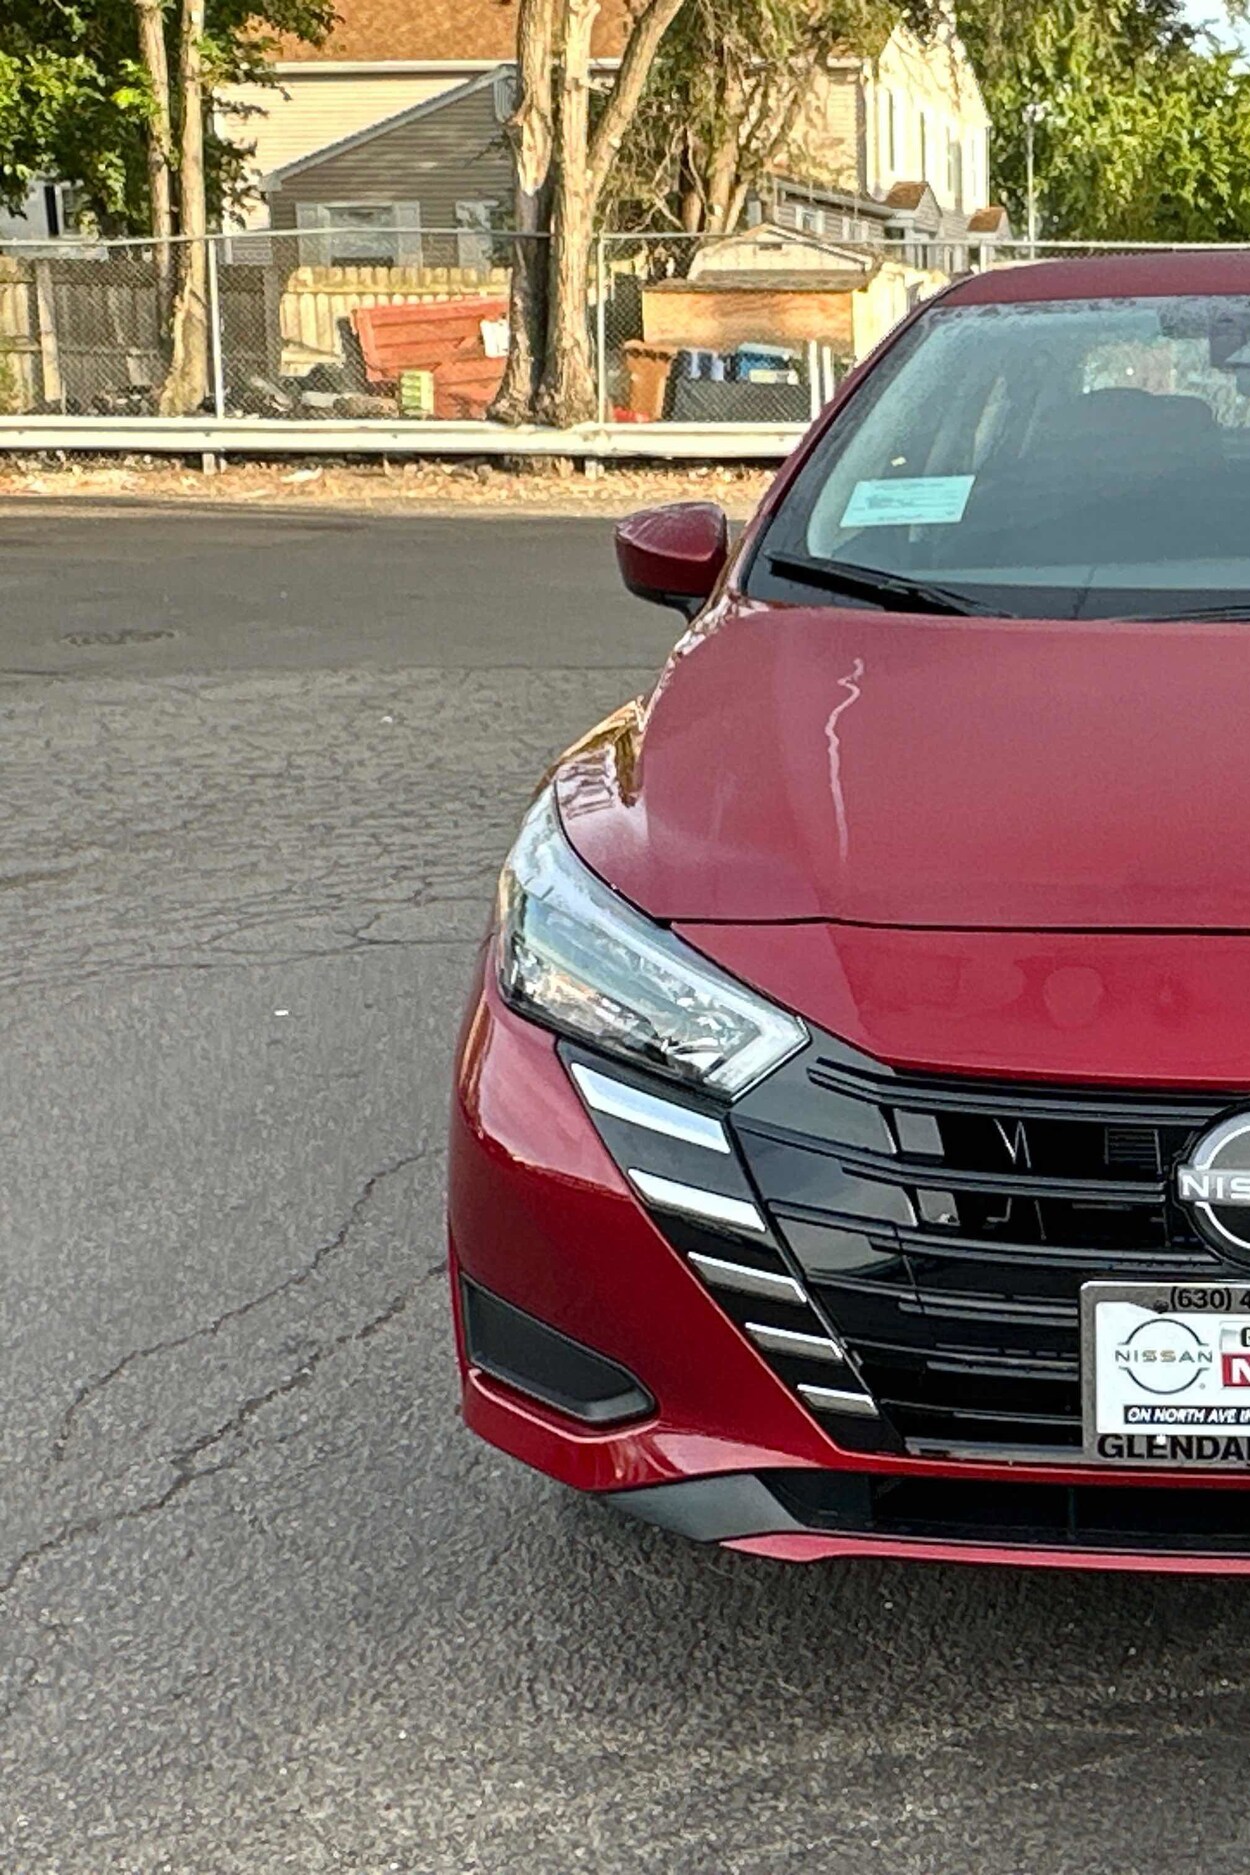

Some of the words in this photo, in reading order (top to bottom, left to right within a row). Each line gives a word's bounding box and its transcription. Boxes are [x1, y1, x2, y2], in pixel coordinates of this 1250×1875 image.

[1170, 1286, 1232, 1311] (630)
[1114, 1349, 1213, 1364] NISSAN
[1127, 1407, 1152, 1422] ON
[1153, 1408, 1207, 1422] NORTH
[1208, 1408, 1238, 1423] AVE
